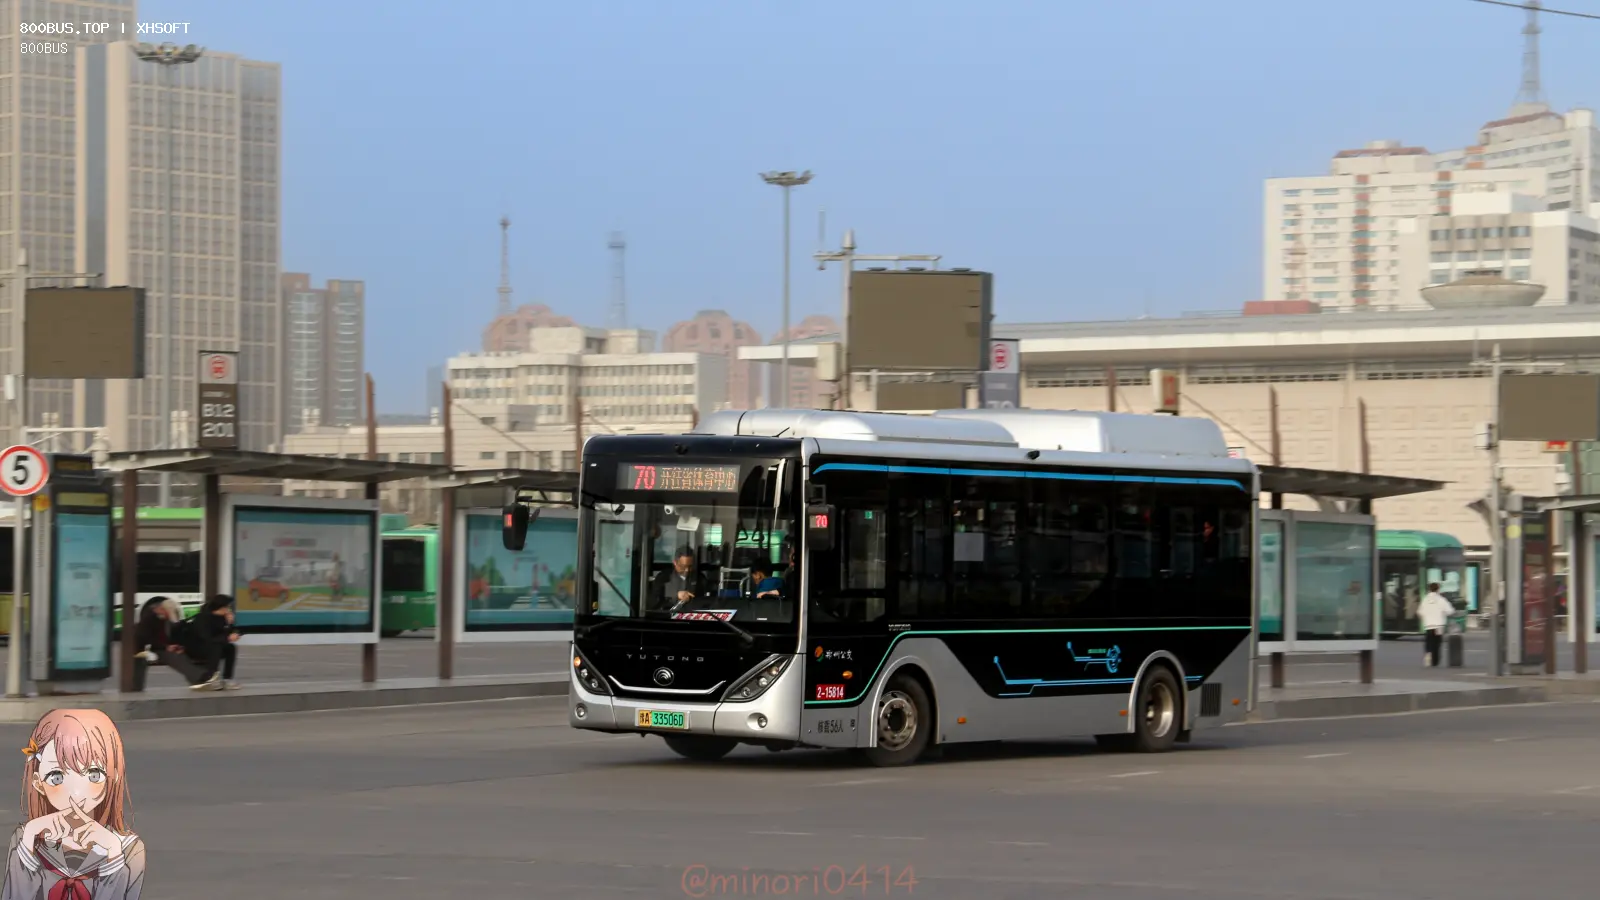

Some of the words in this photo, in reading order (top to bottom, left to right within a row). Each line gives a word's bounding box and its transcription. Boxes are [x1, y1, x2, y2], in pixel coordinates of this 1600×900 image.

[202, 403, 235, 418] B12
[202, 422, 235, 438] 201
[12, 455, 29, 485] 5
[632, 465, 656, 490] 70
[815, 514, 828, 528] 70
[626, 653, 705, 662] YUTONG
[816, 686, 845, 699] 2-15814
